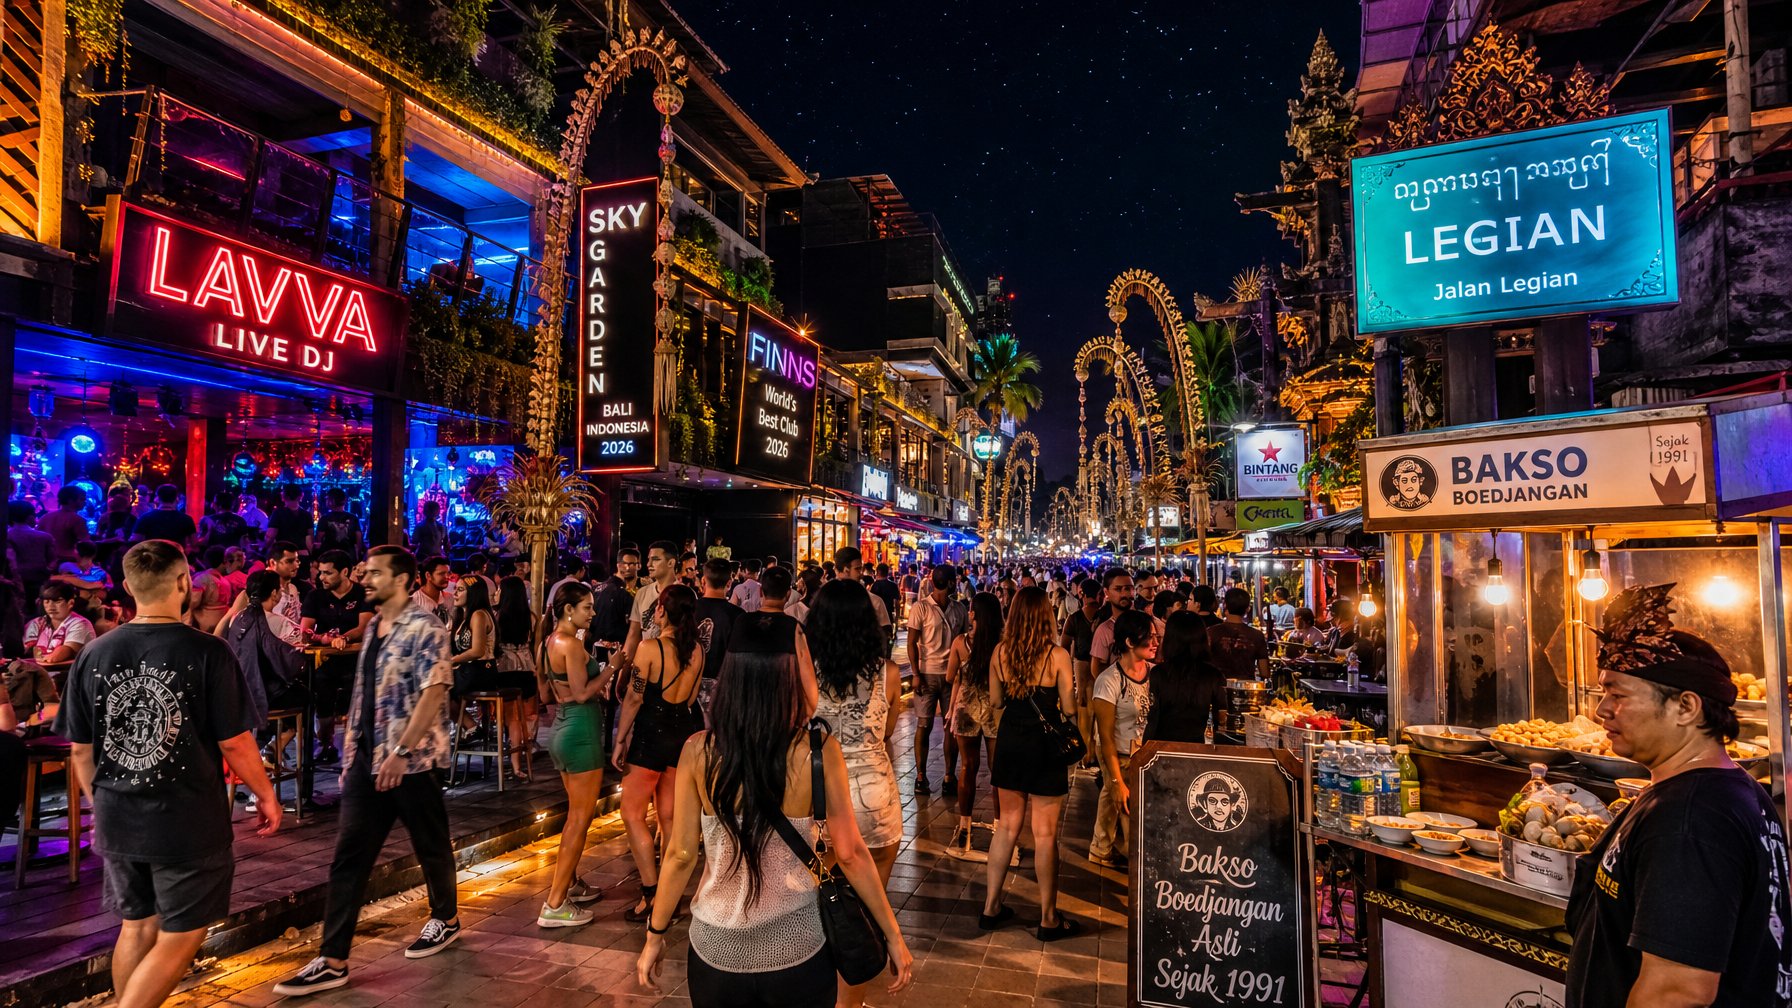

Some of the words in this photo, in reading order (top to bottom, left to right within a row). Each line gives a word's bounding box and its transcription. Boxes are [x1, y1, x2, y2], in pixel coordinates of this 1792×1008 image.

[589, 202, 647, 234] SKY
[1404, 204, 1605, 265] LEGIAN
[151, 226, 377, 353] LAVVA
[1433, 280, 1491, 301] Jalan
[1501, 271, 1578, 295] Legian
[216, 324, 288, 361] LIVE
[303, 344, 334, 372] DJ
[749, 332, 816, 388] FINNS
[603, 403, 631, 417] BALI
[765, 384, 796, 411] World's
[587, 421, 649, 435] INDONESIA
[759, 408, 778, 430] Best
[781, 416, 798, 436] Club
[602, 441, 633, 454] 2026
[766, 437, 788, 457] 2026
[1656, 434, 1689, 450] Sejak
[1658, 449, 1688, 464] 1991
[1244, 463, 1298, 475] BINTANG
[1451, 446, 1588, 485] BAKSO
[1453, 483, 1588, 505] BOEDJANGAN
[1178, 843, 1257, 887] Bakso
[1155, 881, 1283, 927] Boedjangan
[1192, 925, 1240, 960] Asli
[1154, 958, 1225, 1004] Sejak
[1225, 968, 1286, 1004] 1991
